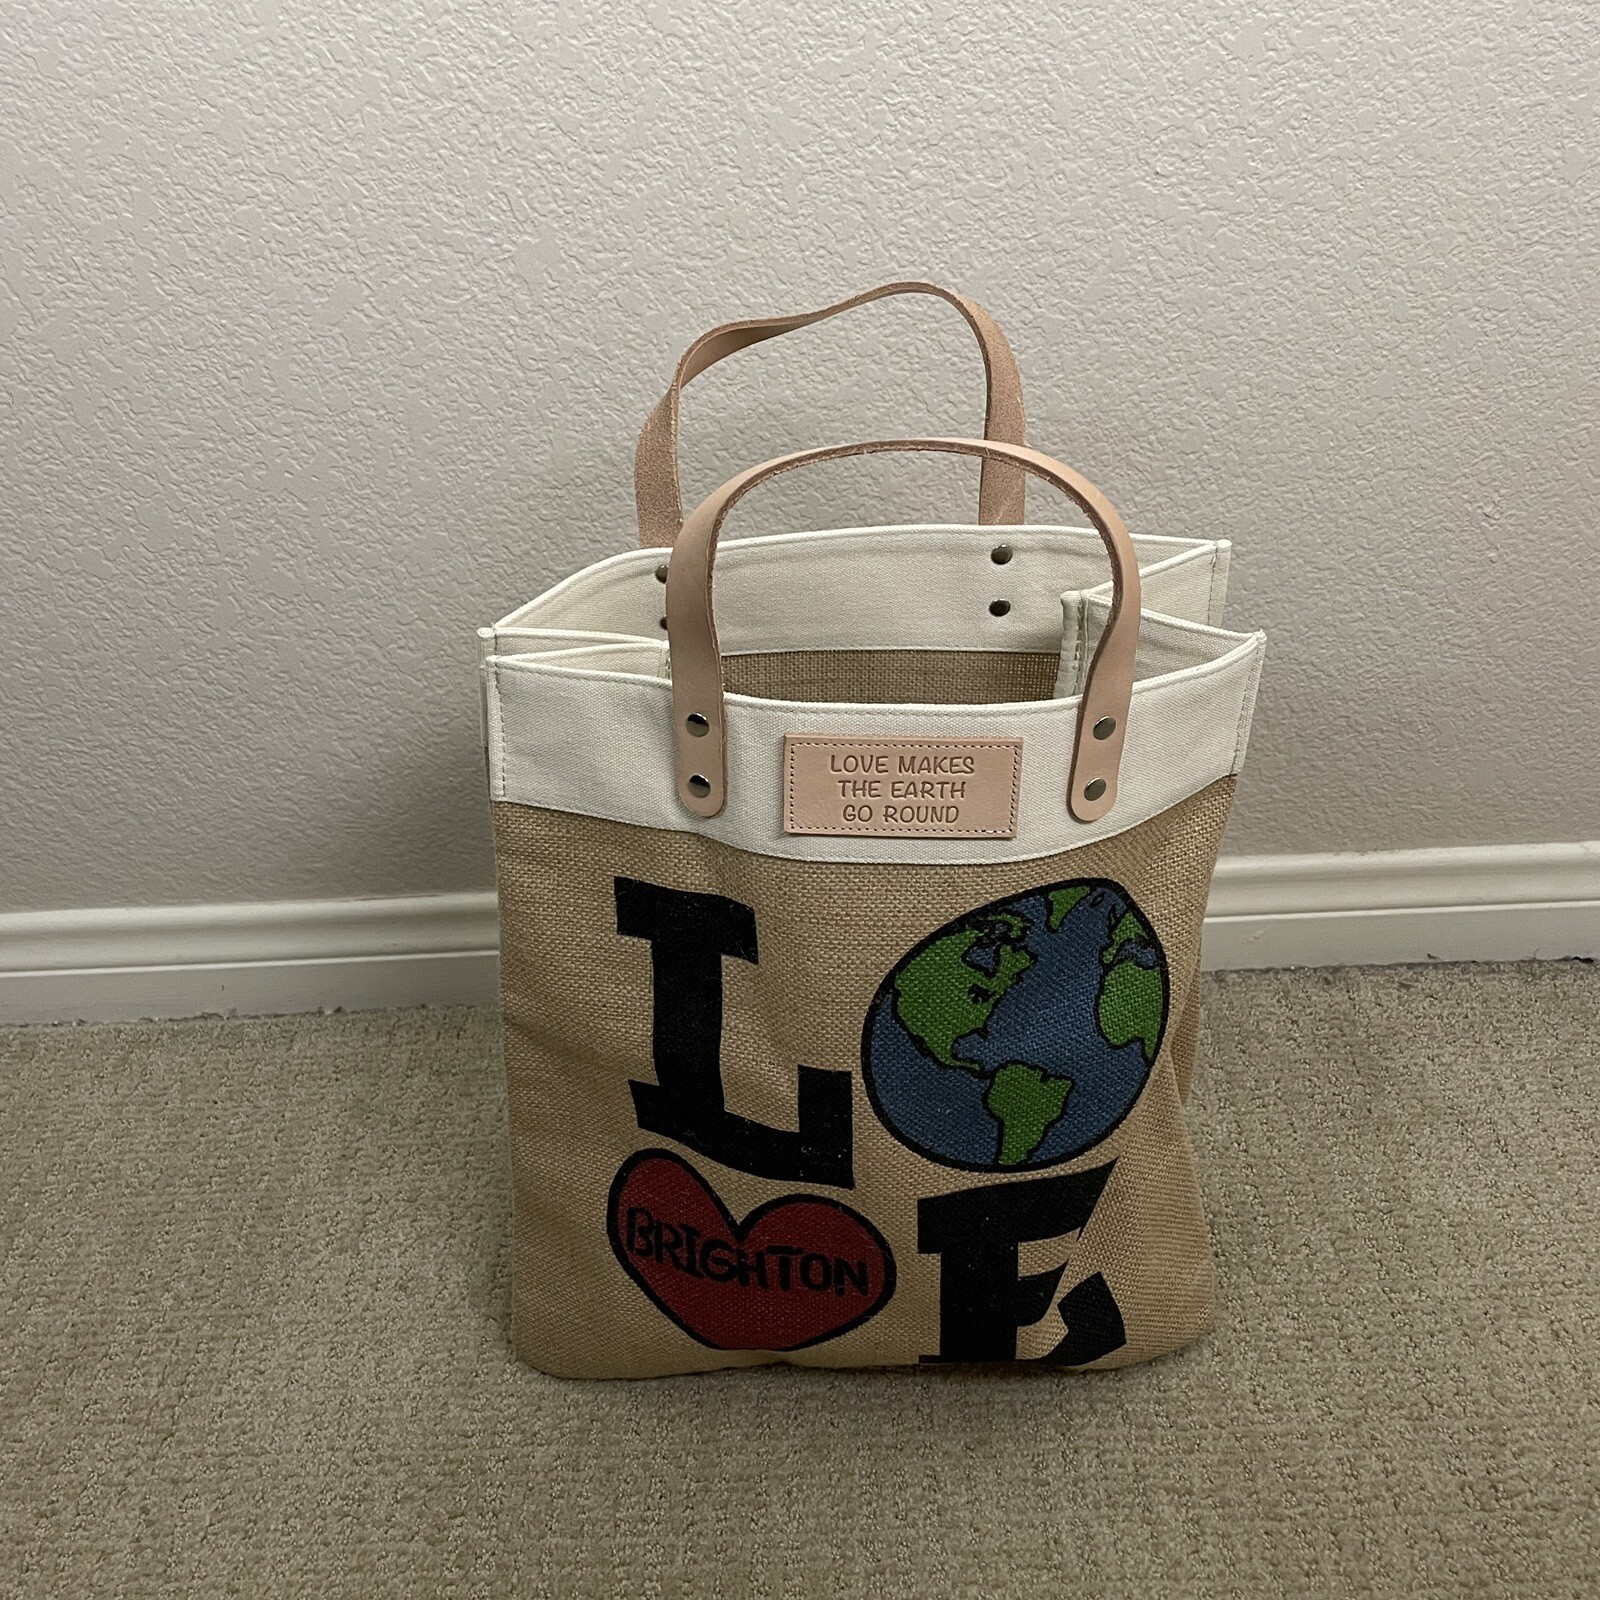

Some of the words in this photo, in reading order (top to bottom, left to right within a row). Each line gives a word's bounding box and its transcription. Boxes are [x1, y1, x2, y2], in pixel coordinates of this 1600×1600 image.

[830, 754, 889, 774] LOVE
[898, 755, 975, 775] MAKES
[838, 780, 882, 798] THE
[890, 781, 967, 800] EARTH
[842, 804, 873, 823] GO
[883, 805, 960, 825] ROUND
[626, 1206, 870, 1298] BRIGHTON
